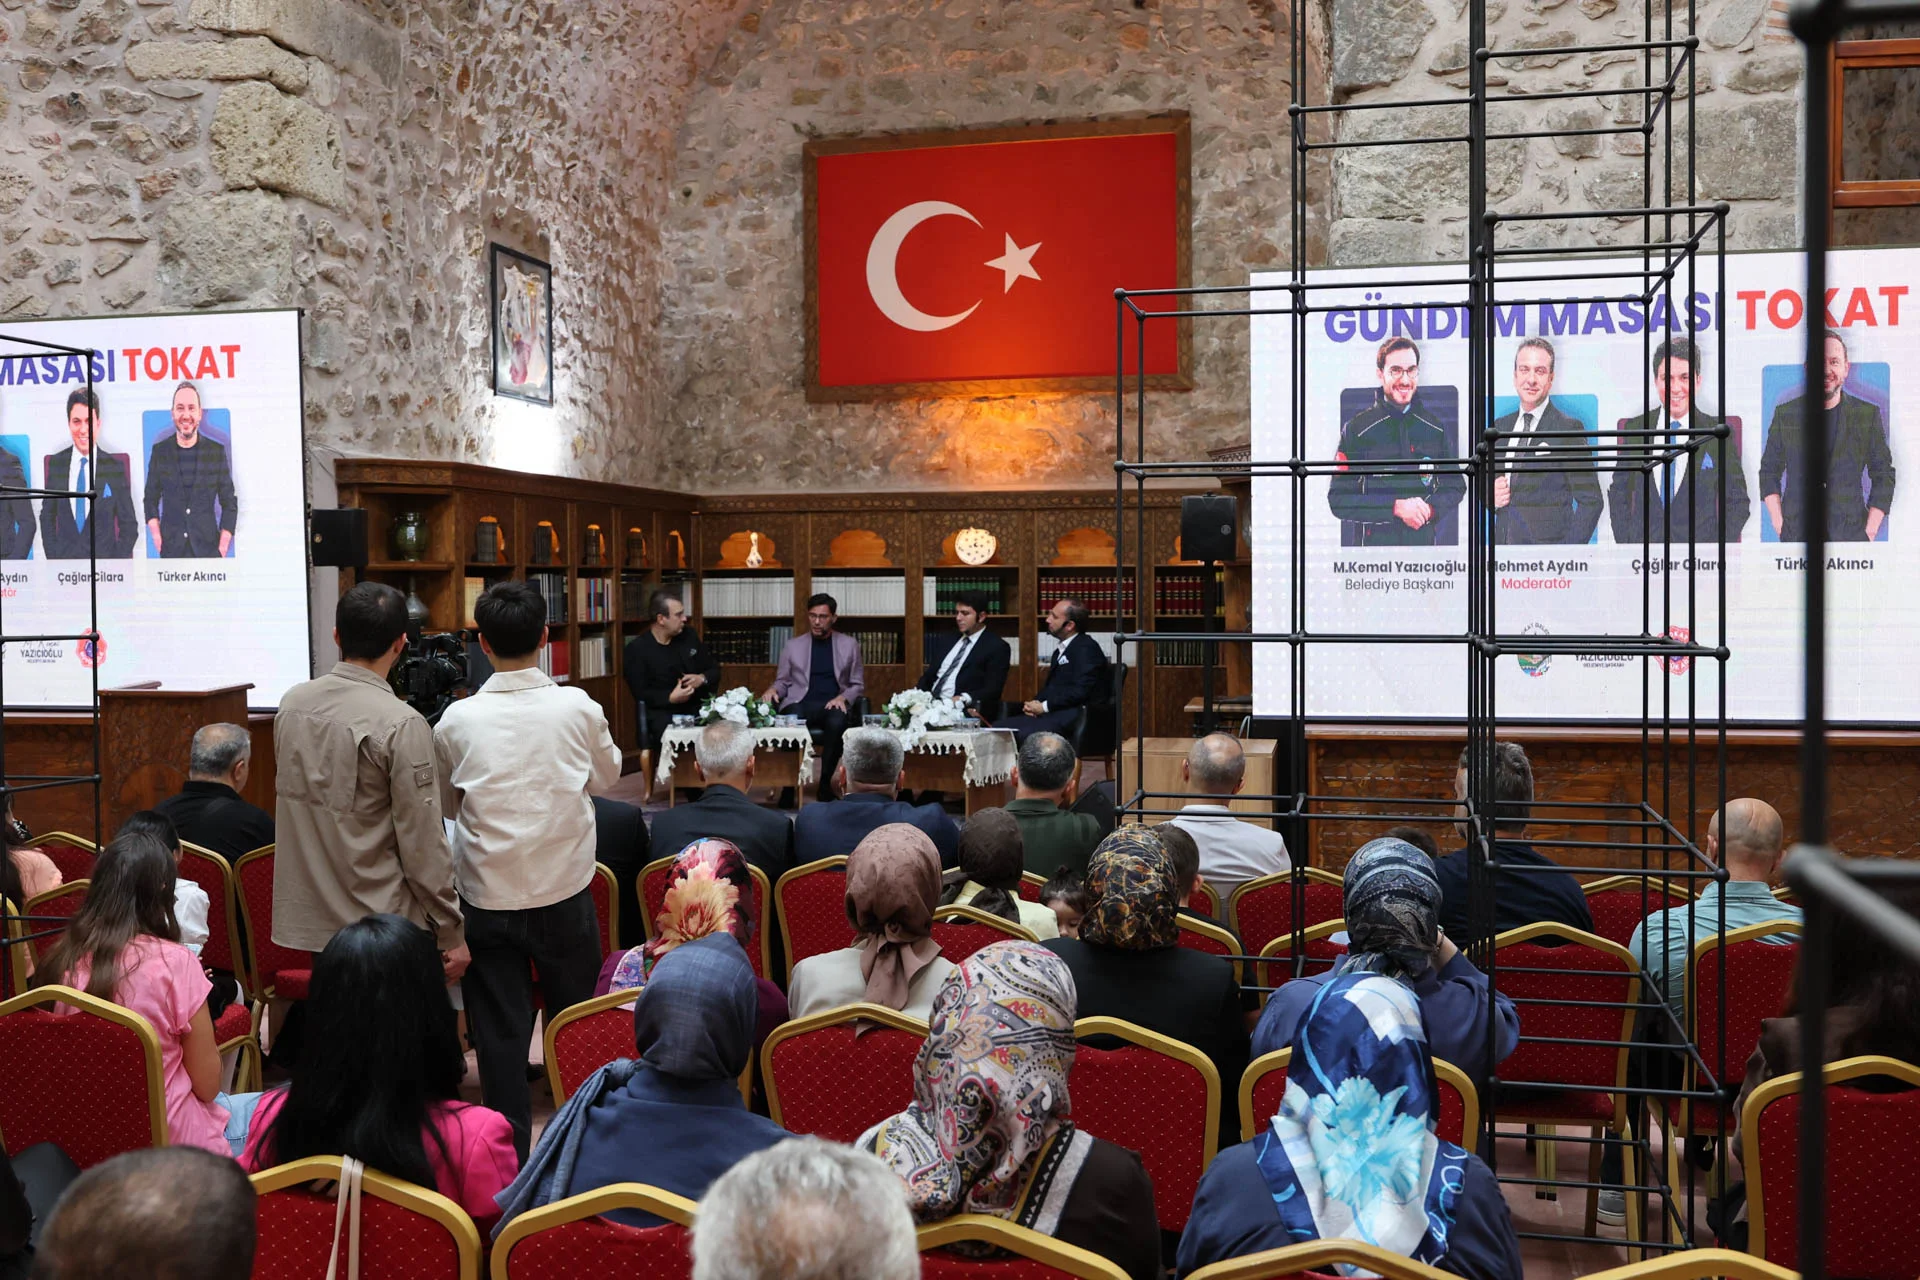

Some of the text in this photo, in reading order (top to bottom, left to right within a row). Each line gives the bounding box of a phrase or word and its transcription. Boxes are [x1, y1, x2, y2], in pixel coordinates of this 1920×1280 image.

[1324, 292, 1526, 343] GÜNDM
[122, 344, 241, 382] TOKAT
[1333, 560, 1466, 576] M.Kemal Yazıcıoğlu
[1546, 560, 1588, 575] Aydın
[1682, 557, 1726, 571] Clar
[1775, 557, 1874, 571] Türk Akıncı
[57, 571, 92, 586] Çağlar
[157, 571, 227, 582] Türker Akıncı
[1501, 577, 1572, 590] Moderatör
[1345, 578, 1454, 594] Belediye Başkanı
